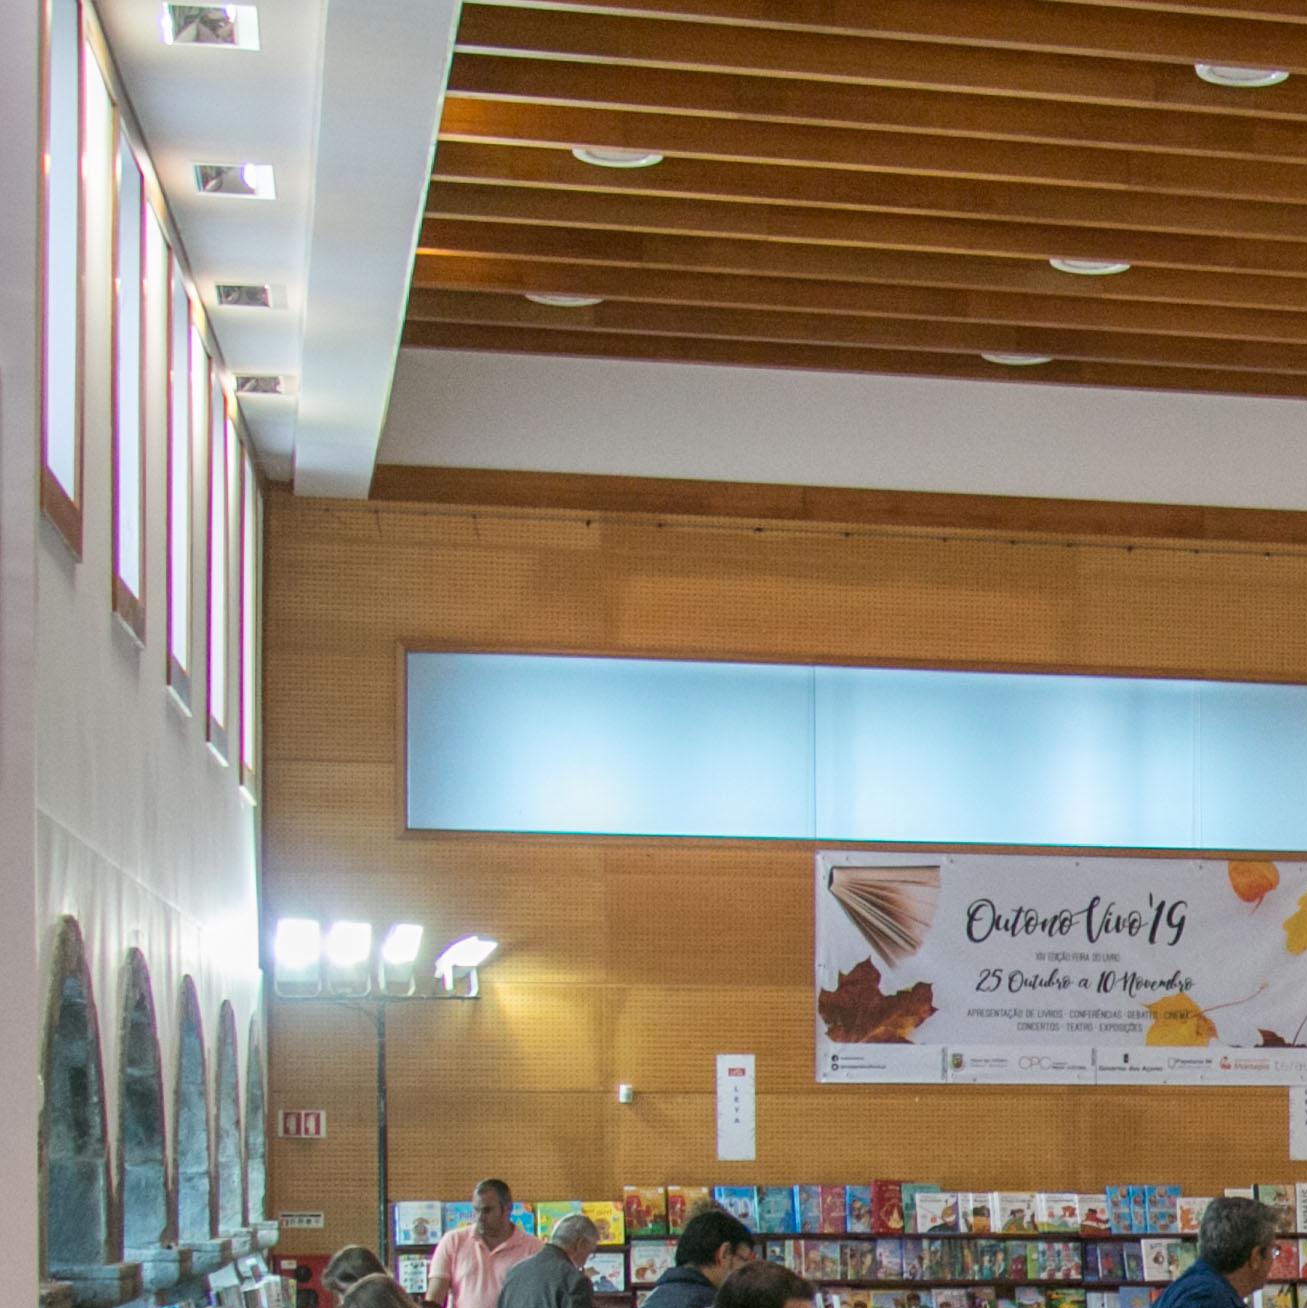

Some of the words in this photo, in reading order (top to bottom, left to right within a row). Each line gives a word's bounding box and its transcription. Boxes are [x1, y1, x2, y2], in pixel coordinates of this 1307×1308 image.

[967, 899, 1076, 943] Outono
[976, 968, 1003, 992] 25
[1008, 968, 1073, 993] Outubro
[1078, 977, 1091, 990] a
[1096, 970, 1116, 993] 10
[1117, 969, 1194, 998] Novembro
[967, 1007, 1024, 1019] APRESENTAÇÃO
[1025, 1008, 1034, 1018] DE
[1037, 1008, 1063, 1018] LIVROS
[1069, 1007, 1122, 1018] CONFERÊNCIAS
[1017, 1022, 1060, 1032] CONCERTOS
[1066, 1022, 1093, 1032] TEATRO
[1099, 1022, 1143, 1034] EXPOSIÇÕES
